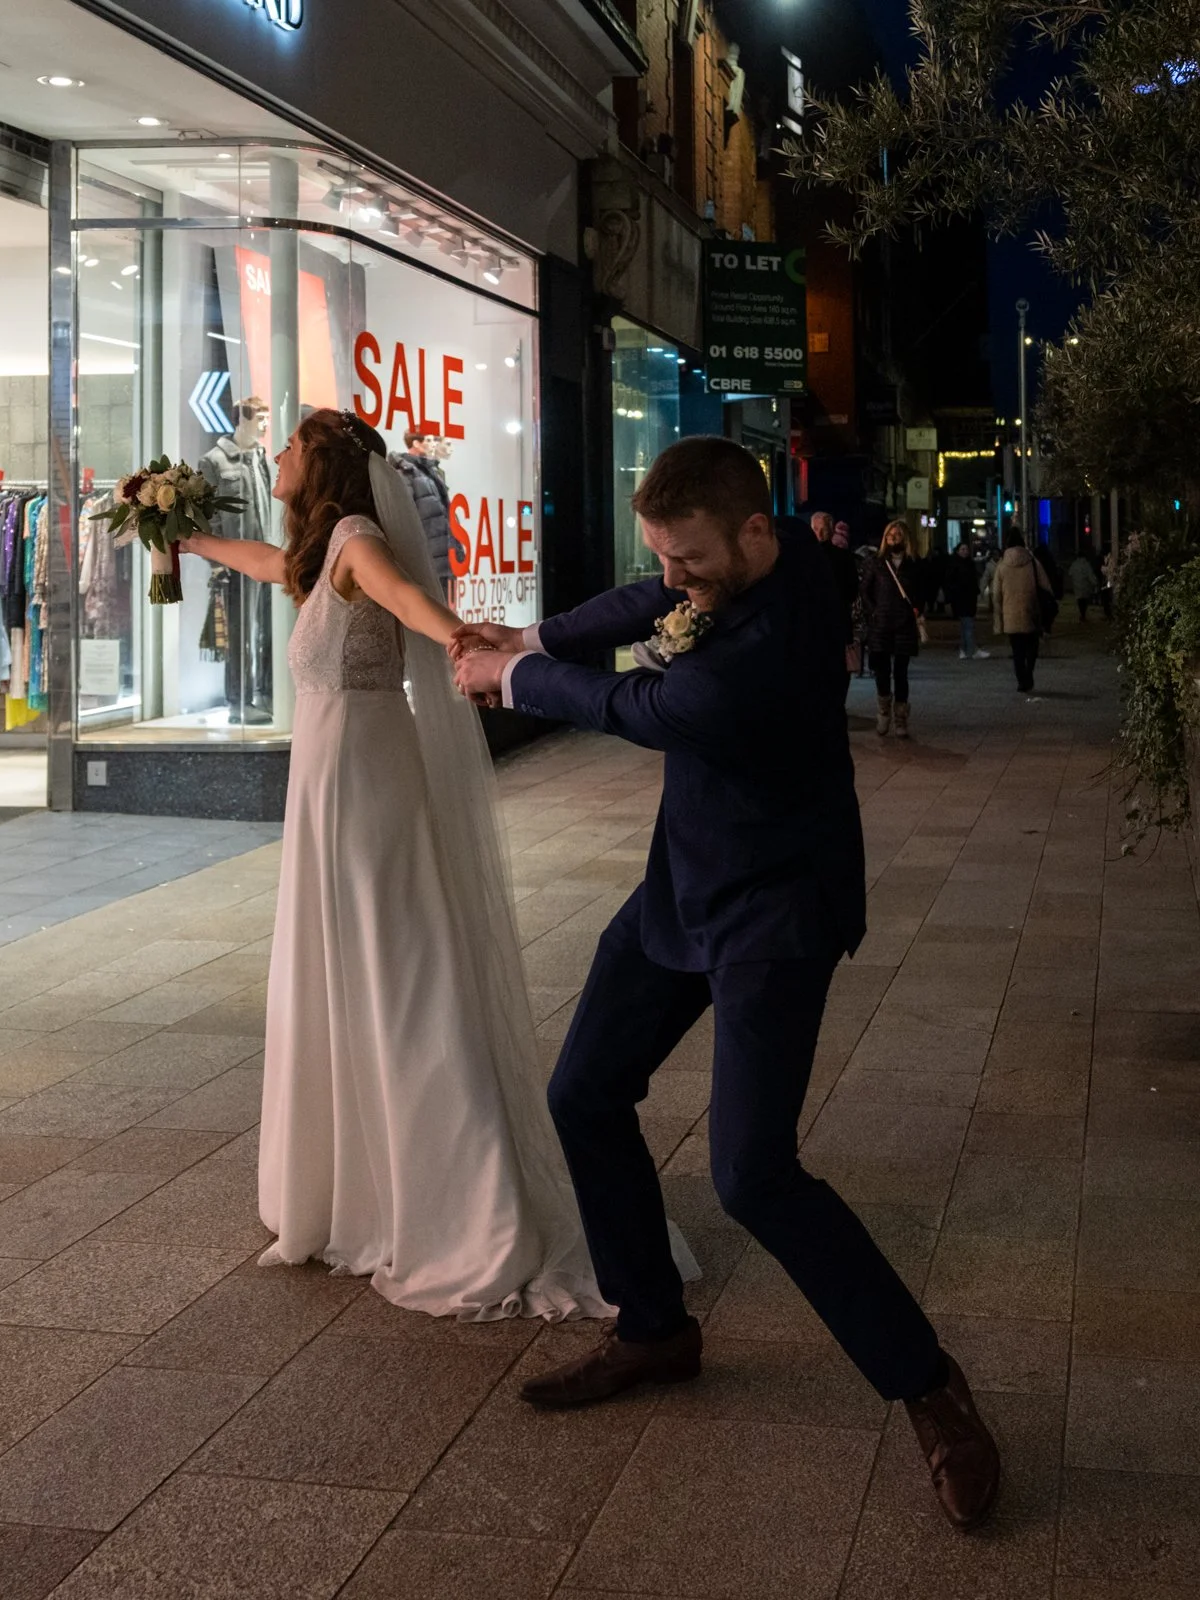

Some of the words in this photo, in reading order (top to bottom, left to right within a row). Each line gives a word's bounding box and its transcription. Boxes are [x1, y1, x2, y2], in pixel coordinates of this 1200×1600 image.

[710, 253, 738, 269] TO
[745, 255, 782, 272] LET
[709, 345, 727, 358] 01
[733, 346, 759, 359] 618
[763, 348, 803, 360] 5500
[353, 331, 465, 440] SALE
[710, 378, 751, 390] CBRE
[448, 493, 534, 577] SALE
[448, 577, 465, 611] UP
[470, 578, 486, 606] TO
[490, 577, 512, 604] 70%
[516, 576, 536, 602] OFF
